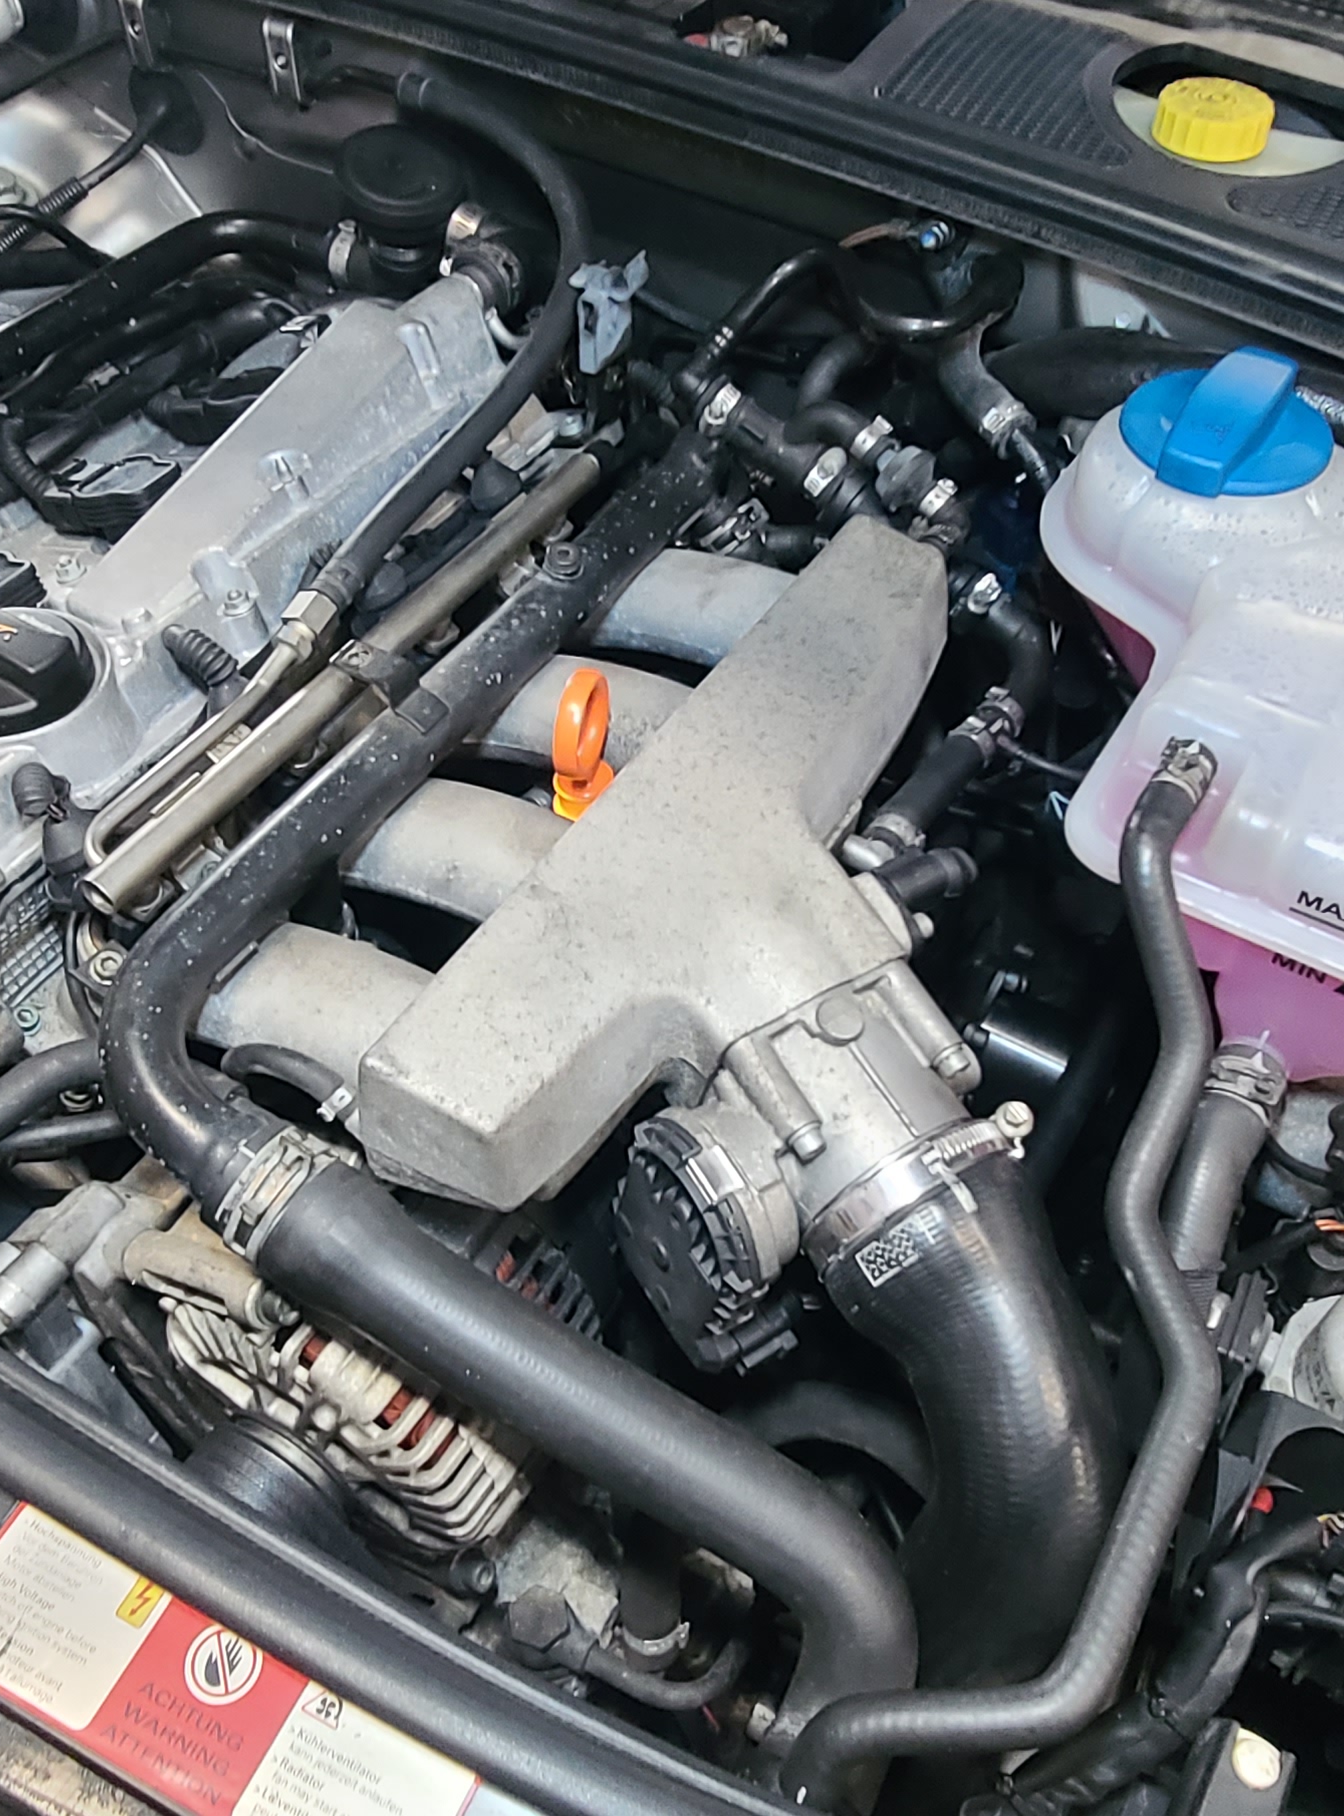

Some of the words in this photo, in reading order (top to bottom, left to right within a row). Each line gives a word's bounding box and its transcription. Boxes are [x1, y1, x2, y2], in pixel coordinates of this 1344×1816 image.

[1272, 952, 1327, 984] MIN
[17, 1583, 57, 1612] Voltage
[50, 1640, 88, 1667] system
[63, 1628, 99, 1654] before
[34, 1669, 64, 1692] avant
[138, 1682, 244, 1752] ACHTUNG
[124, 1701, 230, 1777] WARNING
[100, 1722, 223, 1806] ATTENTION
[269, 1770, 290, 1788] fan
[277, 1756, 327, 1792] Radiator
